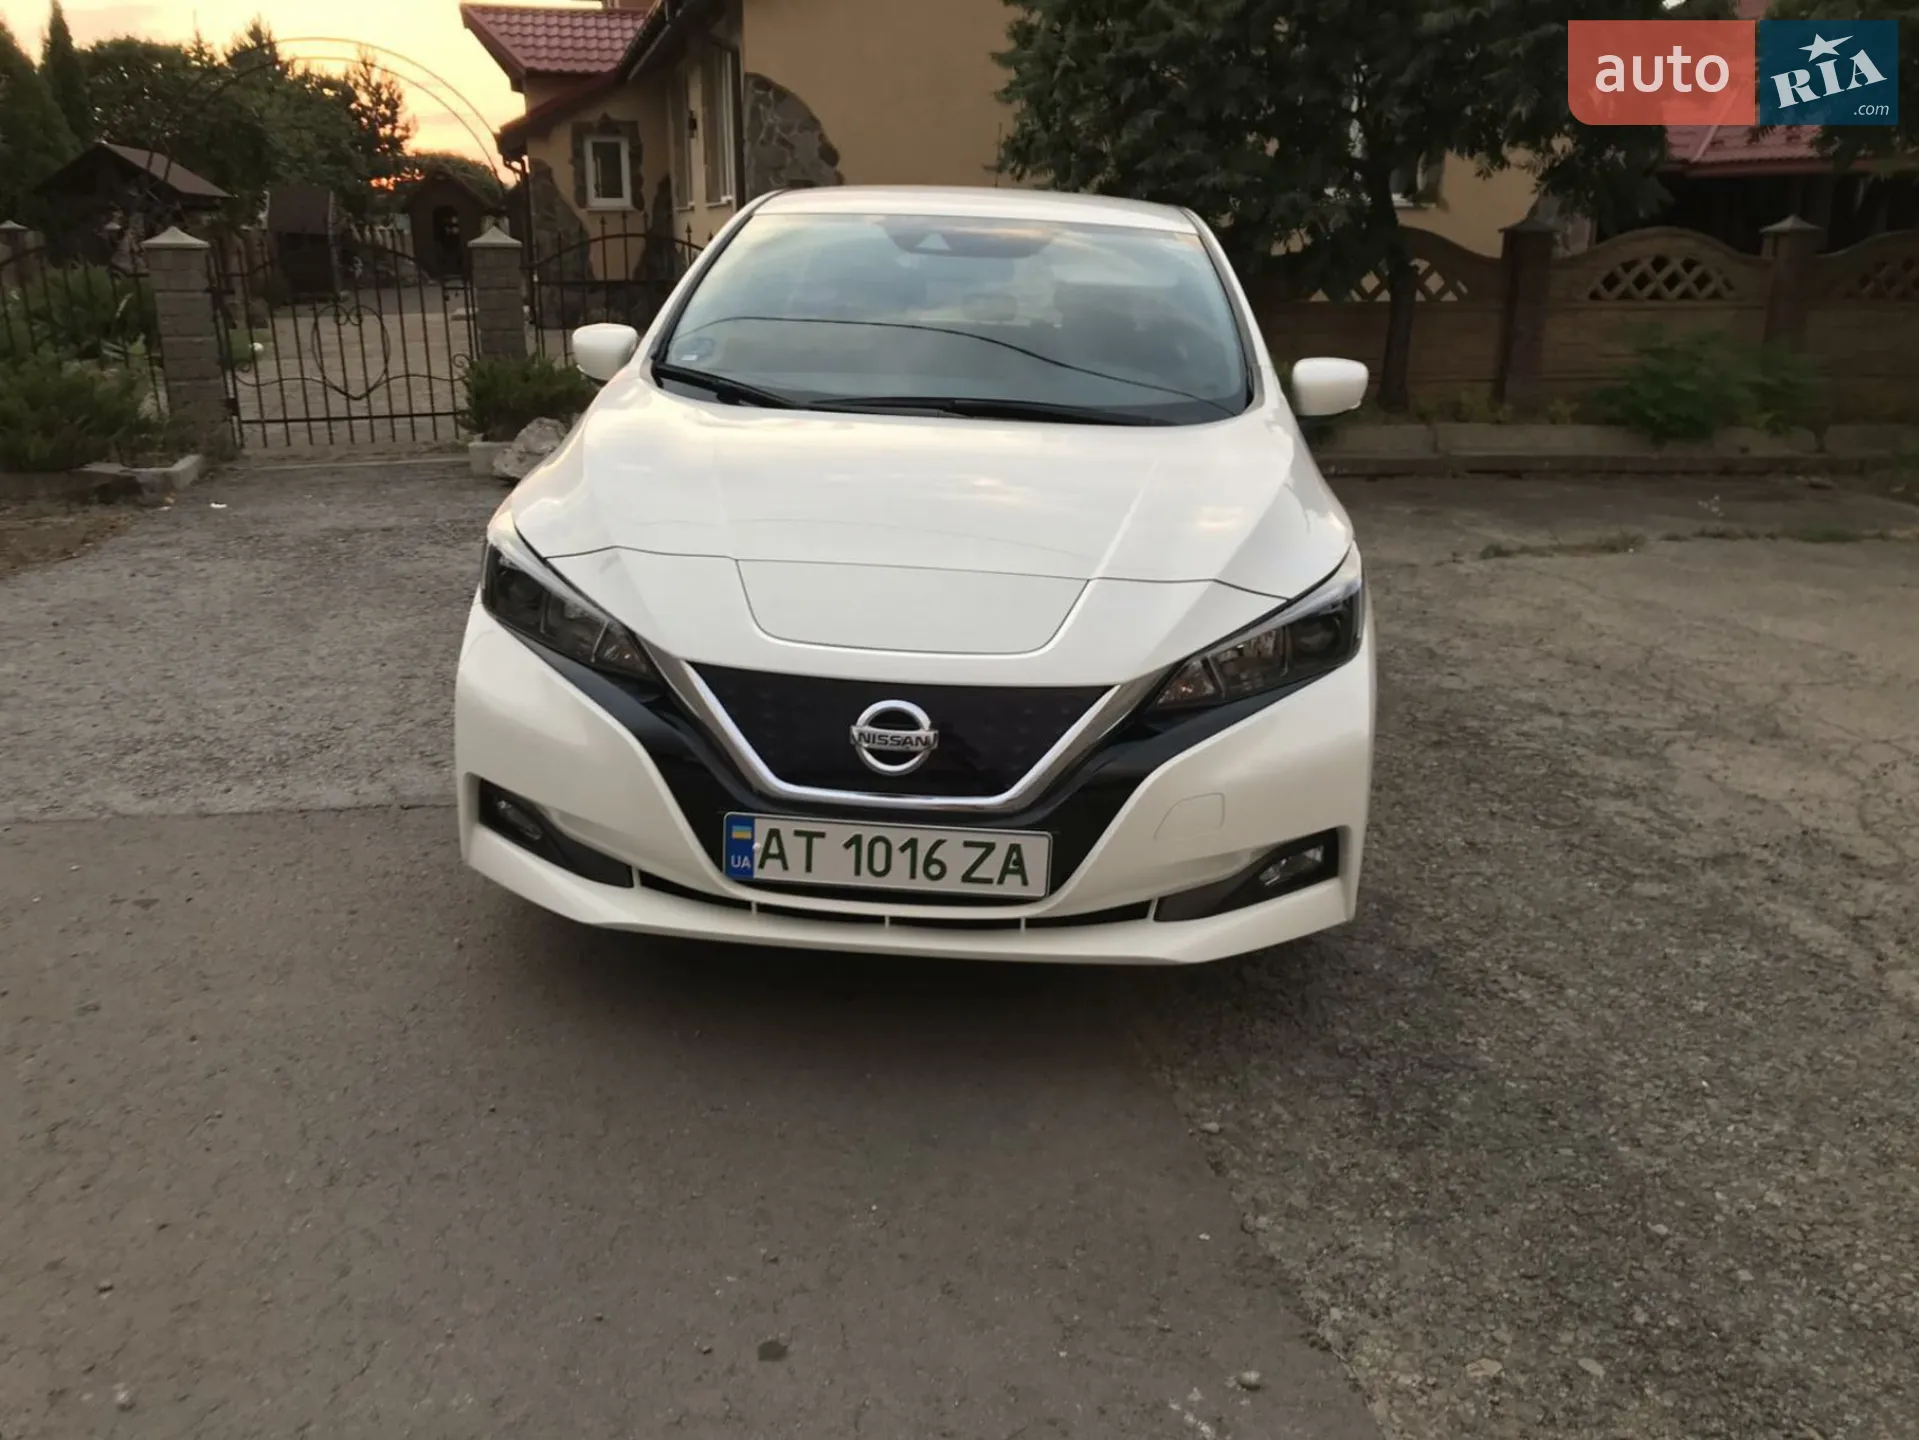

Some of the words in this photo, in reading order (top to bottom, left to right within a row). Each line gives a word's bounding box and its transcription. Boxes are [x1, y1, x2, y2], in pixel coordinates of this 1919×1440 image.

[857, 731, 932, 748] NISSAN
[731, 854, 751, 869] UA
[757, 828, 827, 873] AT
[842, 833, 948, 881] 1016
[961, 840, 1029, 886] ZA
